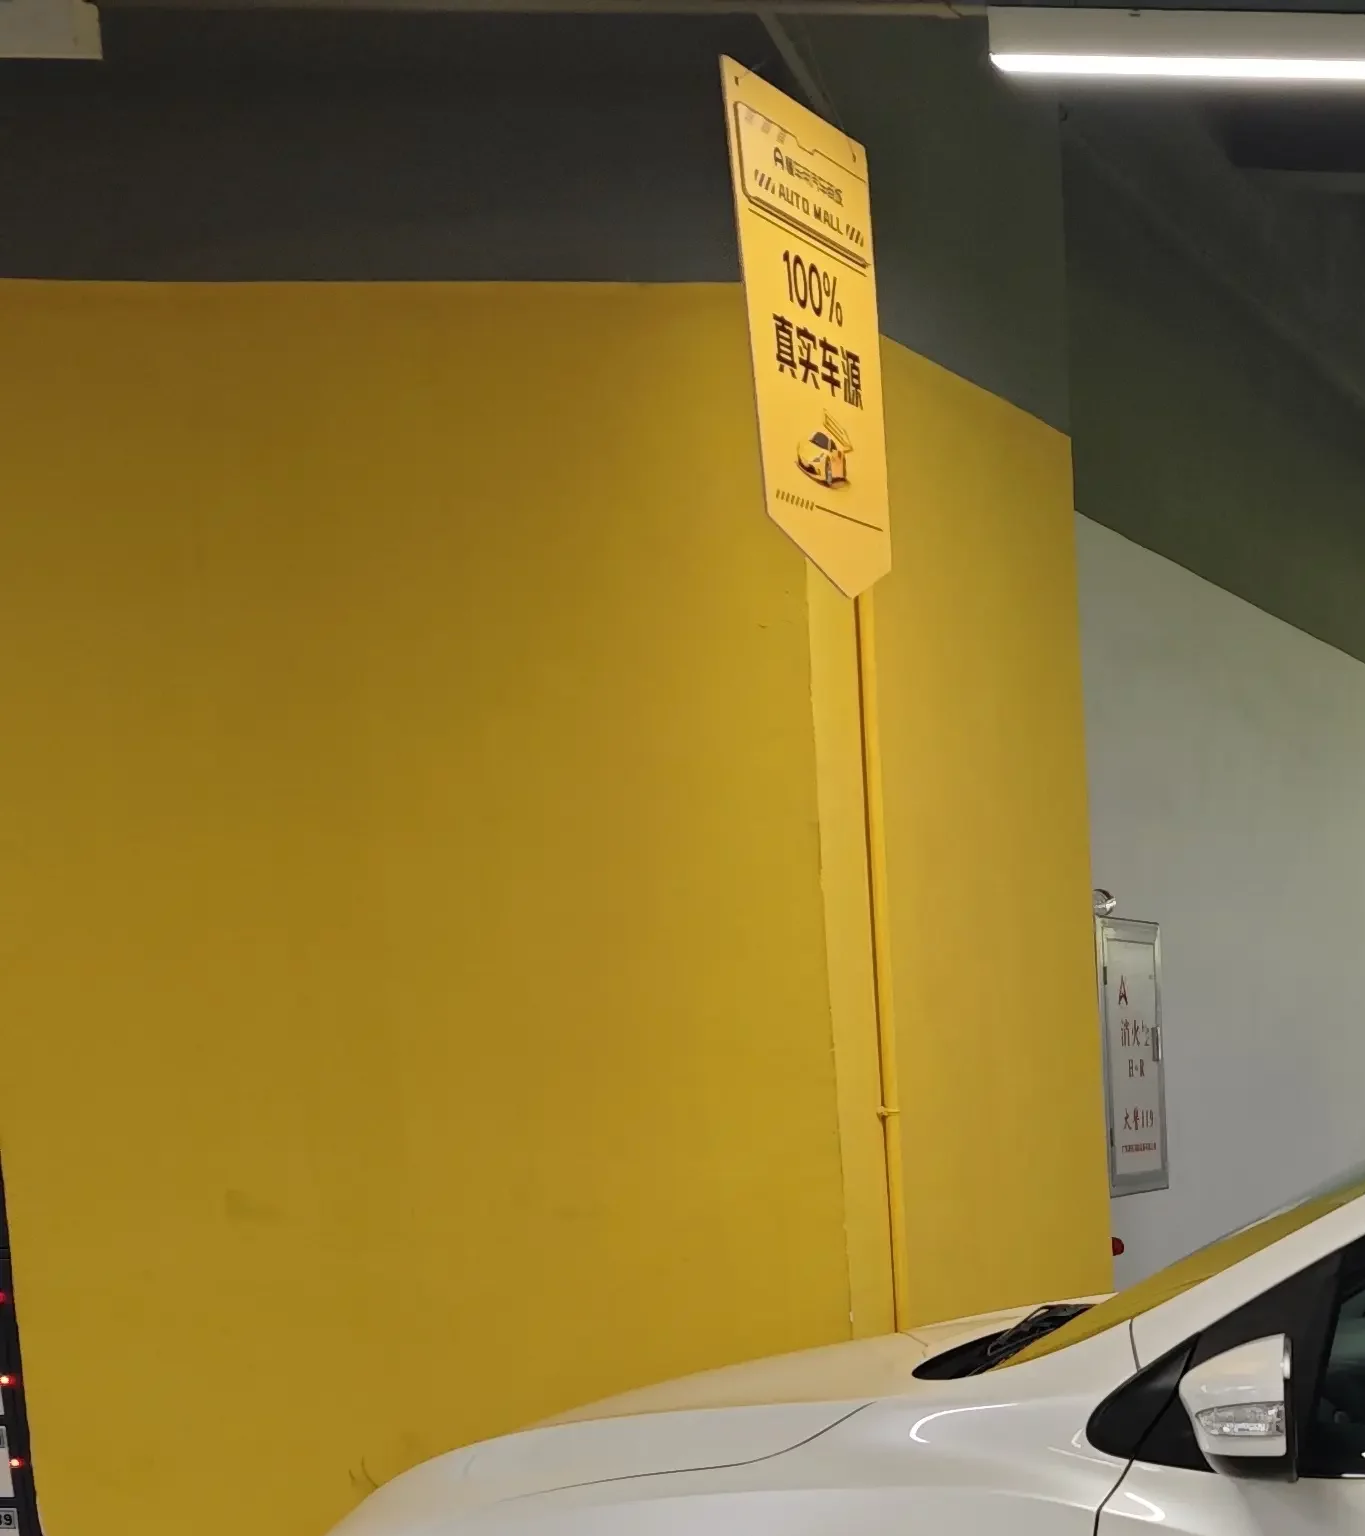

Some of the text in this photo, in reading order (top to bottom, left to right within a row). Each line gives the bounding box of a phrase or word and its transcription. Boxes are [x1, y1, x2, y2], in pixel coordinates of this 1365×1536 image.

[778, 183, 843, 235] AUTO MALL
[782, 249, 843, 327] 100%
[772, 312, 864, 411] 真实车源
